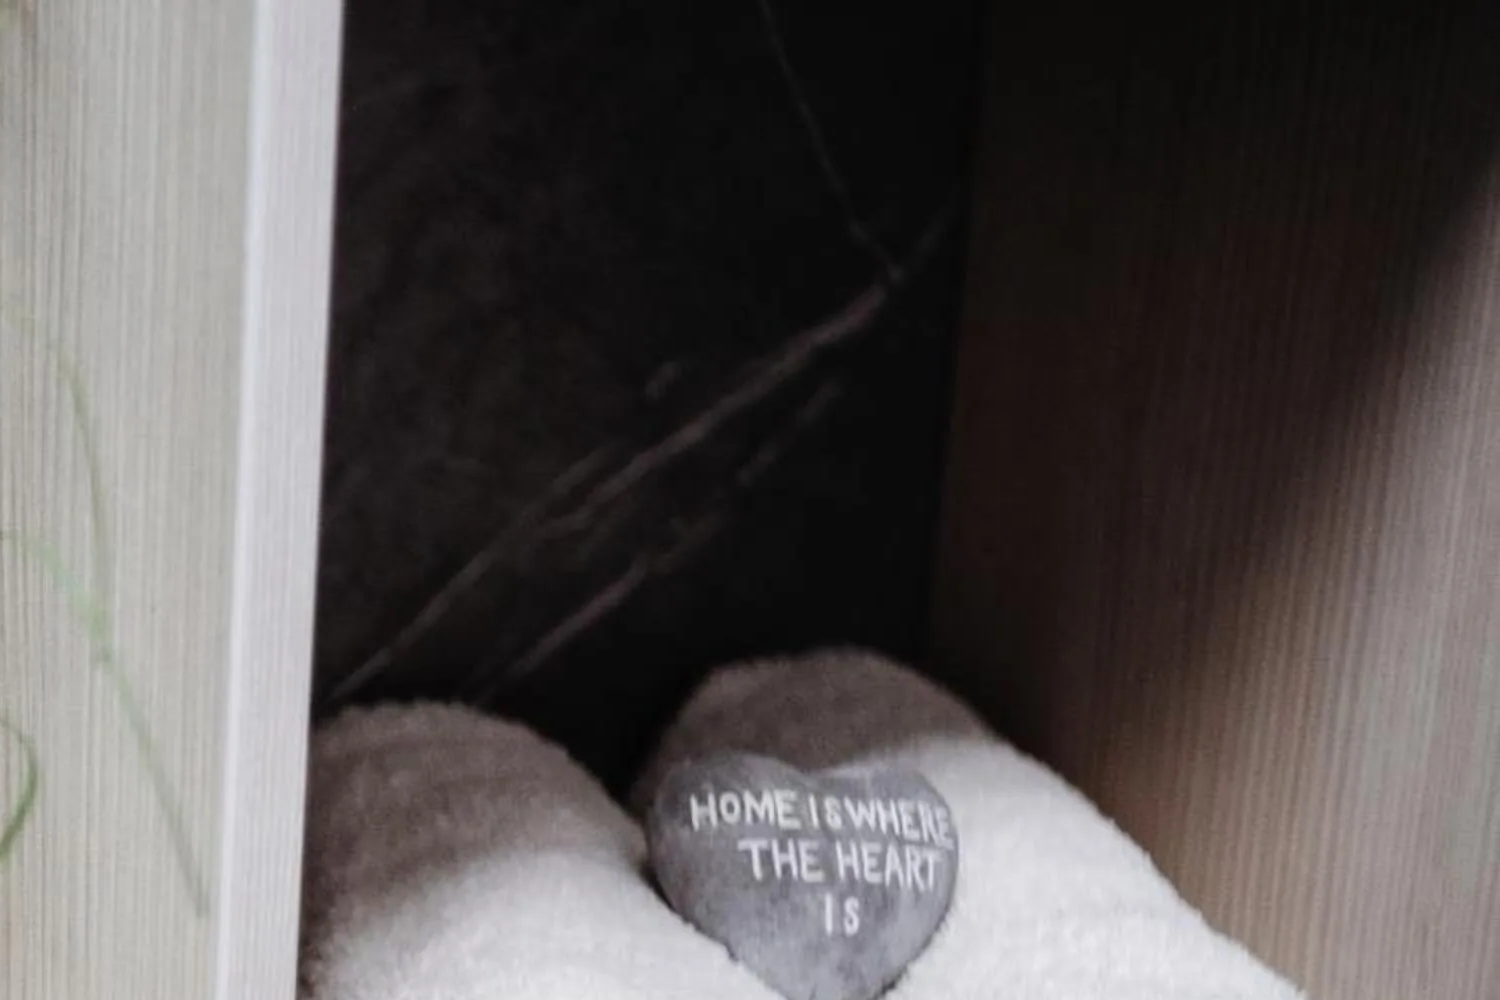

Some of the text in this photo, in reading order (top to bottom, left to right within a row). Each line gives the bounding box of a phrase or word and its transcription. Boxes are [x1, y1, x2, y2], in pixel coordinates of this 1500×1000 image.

[690, 789, 954, 850] HOME IS WHERE
[737, 838, 940, 892] THE HEART
[825, 892, 860, 936] IS
